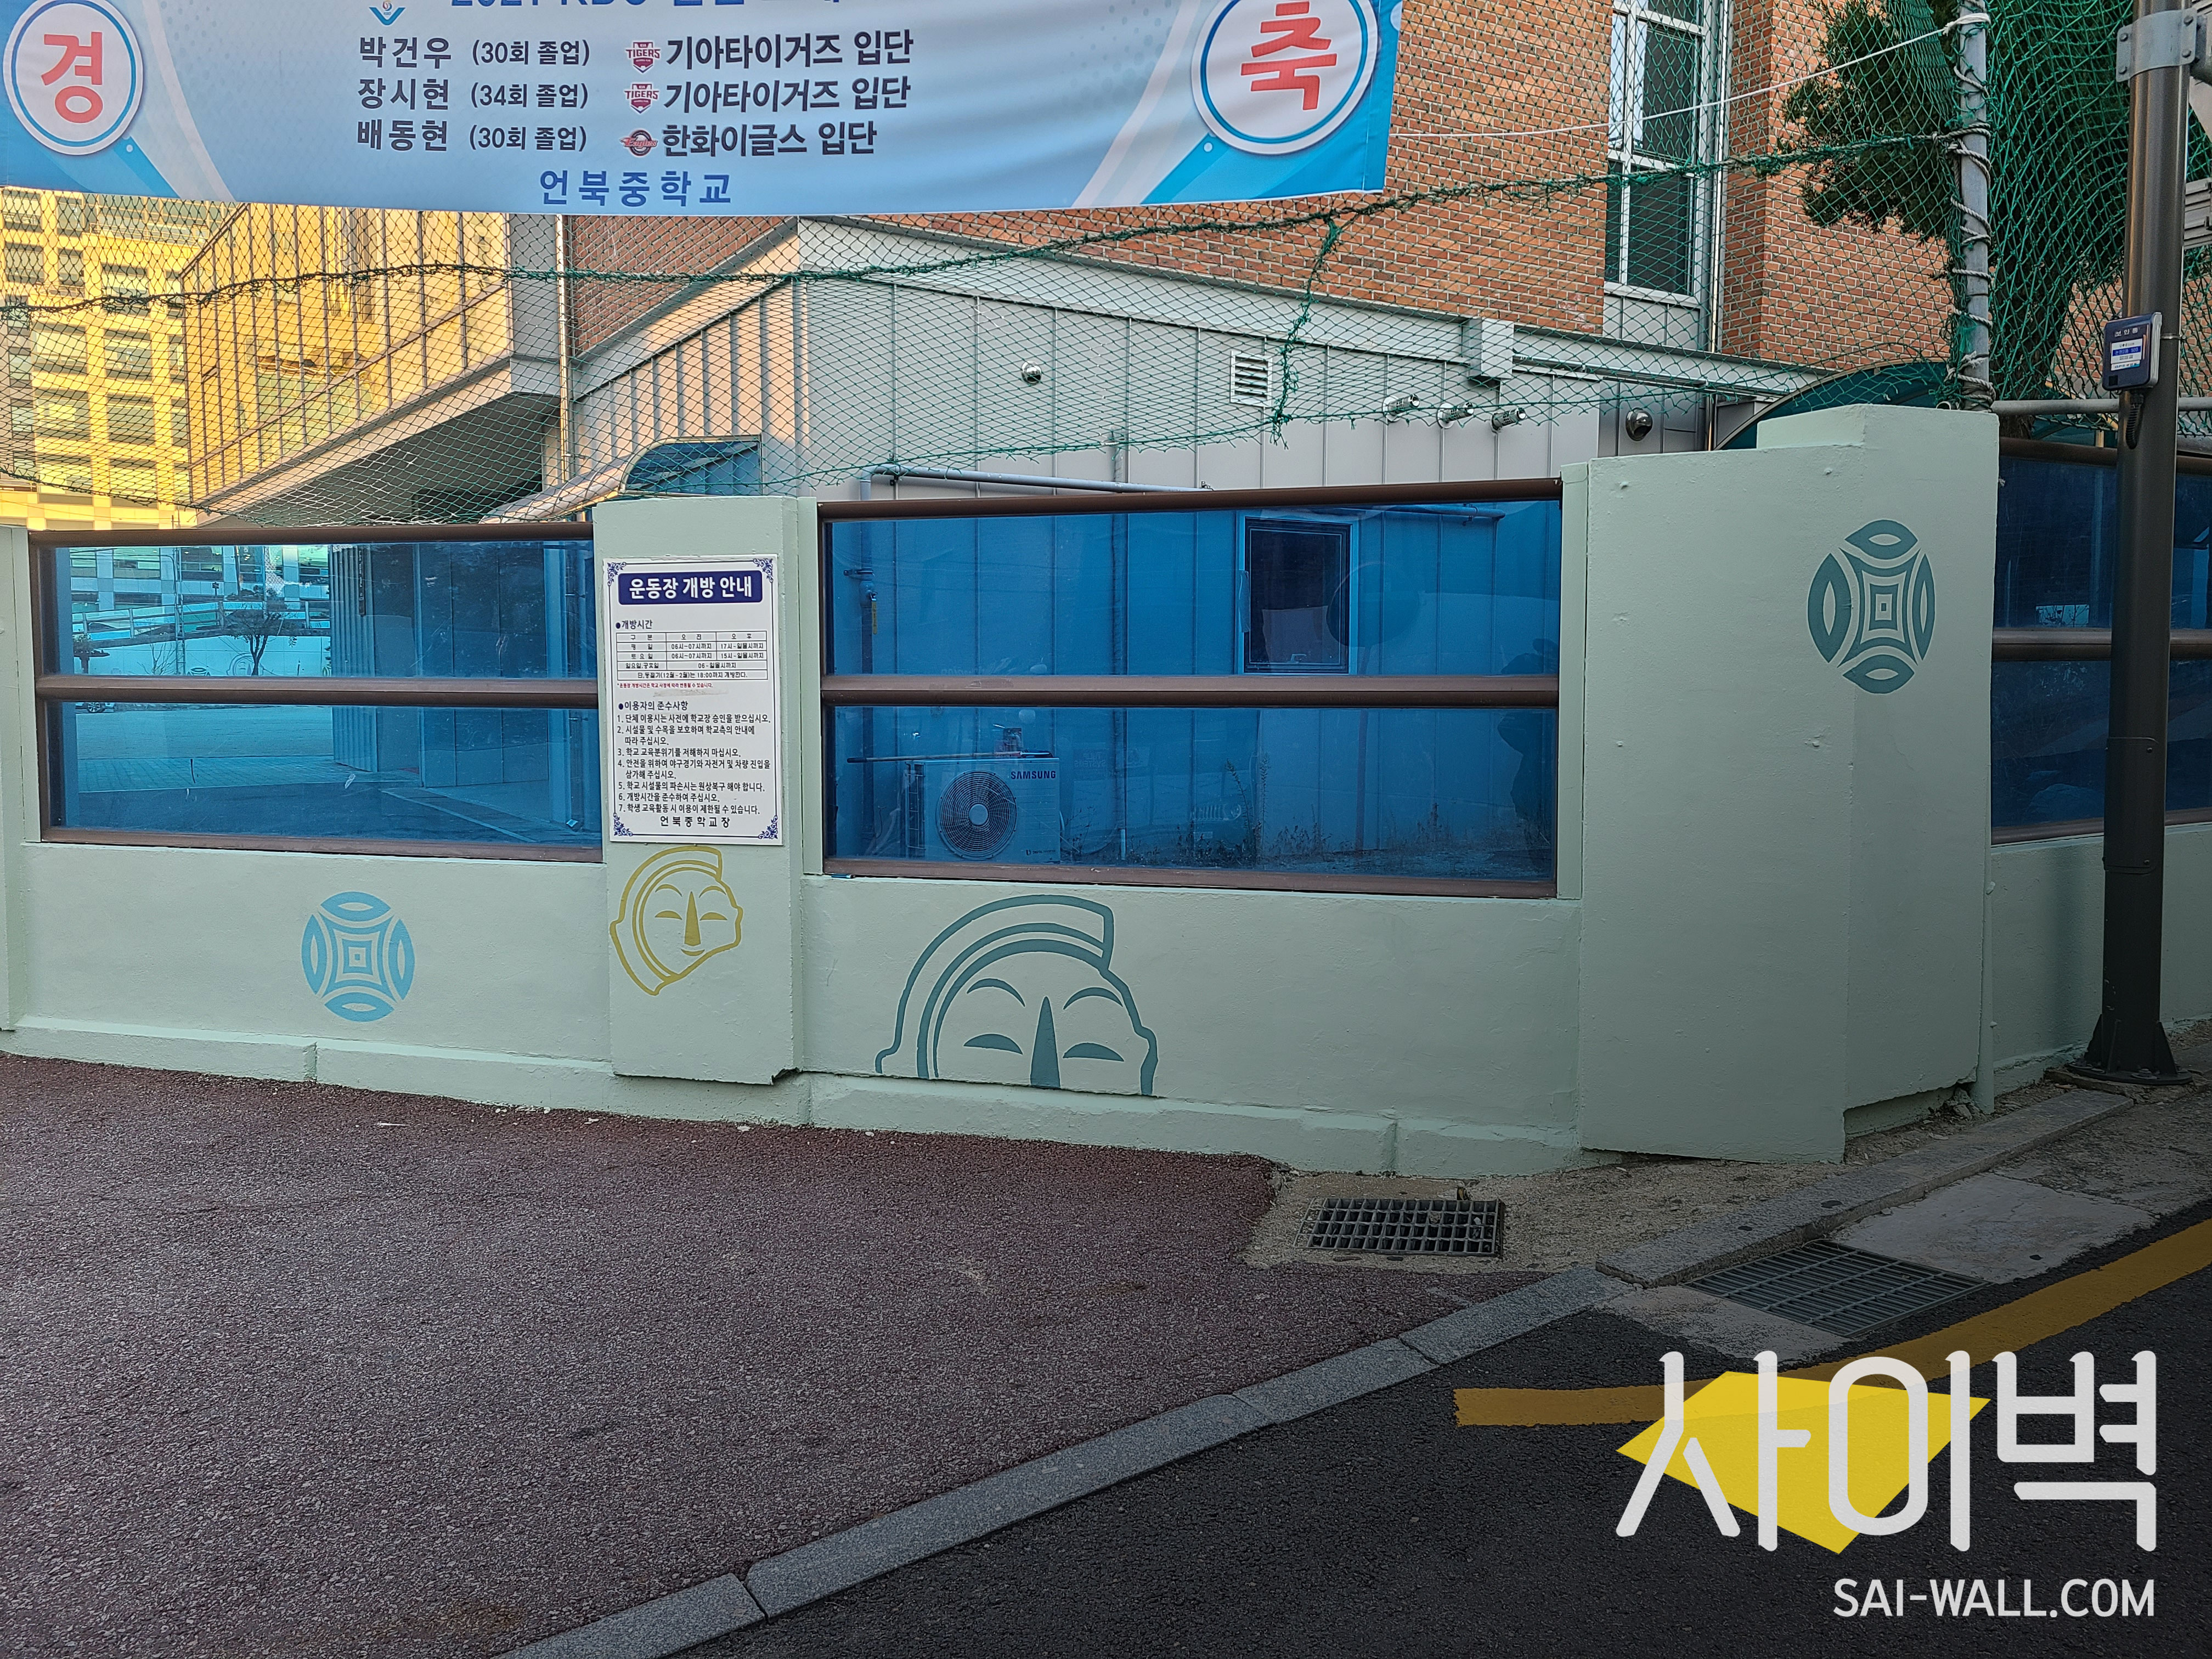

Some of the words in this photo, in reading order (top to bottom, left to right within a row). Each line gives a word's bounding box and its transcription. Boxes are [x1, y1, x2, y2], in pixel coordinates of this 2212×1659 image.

[360, 37, 451, 69] 박건우
[473, 40, 528, 65] (30회
[538, 40, 589, 66] 졸업)
[626, 49, 661, 59] TIGERS
[667, 33, 842, 70] 기아타이거즈
[854, 29, 913, 65] 입단
[1241, 1, 1338, 110] 축
[41, 33, 104, 123] 경
[358, 78, 448, 110] 장시현
[471, 82, 527, 108] (34회
[537, 83, 588, 109] 졸업)
[624, 91, 659, 99] TIGERS
[664, 80, 839, 113] 기아타이거즈
[852, 76, 911, 110] 입단
[358, 119, 447, 151] 배동현
[470, 125, 526, 150] (30회
[535, 126, 586, 151] 졸업)
[663, 125, 807, 157] 한화이글스
[819, 121, 877, 155] 입단
[620, 137, 658, 149] Eagles
[540, 170, 730, 207] 언북중학교
[629, 578, 679, 599] 운동장
[682, 577, 715, 599] 개방
[720, 575, 752, 597] 안내
[622, 620, 652, 629] 개방시간
[625, 701, 654, 710] 이용자의
[657, 701, 688, 710] 준수사항
[626, 714, 638, 723] 단체
[641, 714, 667, 723] 이용시는
[669, 714, 688, 723] 사전에
[691, 714, 710, 723] 학교장
[712, 714, 732, 723] 승인을
[735, 714, 770, 723] 받으십시오.
[626, 725, 645, 734] 시설물
[647, 725, 653, 734] 및
[655, 725, 675, 734] 수목을
[677, 725, 703, 734] 보호하며
[706, 725, 732, 735] 학교측의
[735, 726, 754, 735] 안내에
[625, 737, 638, 746] 따라
[640, 737, 669, 746] 주십시오.
[626, 748, 639, 757] 학교
[641, 748, 681, 757] 교육분위기를
[683, 748, 709, 757] 저해하지
[712, 748, 741, 757] 마십시오.
[627, 759, 646, 768] 안전을
[648, 759, 667, 768] 위하여
[670, 759, 703, 768] 야구경기와
[705, 759, 724, 769] 자전거
[727, 760, 733, 769] 및
[735, 760, 748, 769] 차량
[751, 760, 770, 769] 진입을
[626, 770, 645, 779] 삼가해
[647, 770, 676, 779] 주십시오.
[1011, 771, 1056, 779] SAMSUNG
[627, 781, 640, 790] 학교
[642, 782, 668, 791] 시설물의
[670, 782, 697, 791] 파손시는
[698, 782, 725, 791] 원상복구
[727, 782, 740, 791] 해야
[742, 782, 765, 792] 합니다.
[627, 793, 660, 802] 개방시간을
[662, 793, 688, 802] 준수하여
[690, 793, 719, 802] 주십시오.
[627, 804, 640, 812] 학생
[642, 804, 668, 812] 교육활동
[670, 804, 676, 813] 시
[679, 804, 698, 813] 이용이
[700, 805, 720, 814] 제한될
[722, 805, 729, 814] 수
[731, 805, 760, 815] 있습니다.
